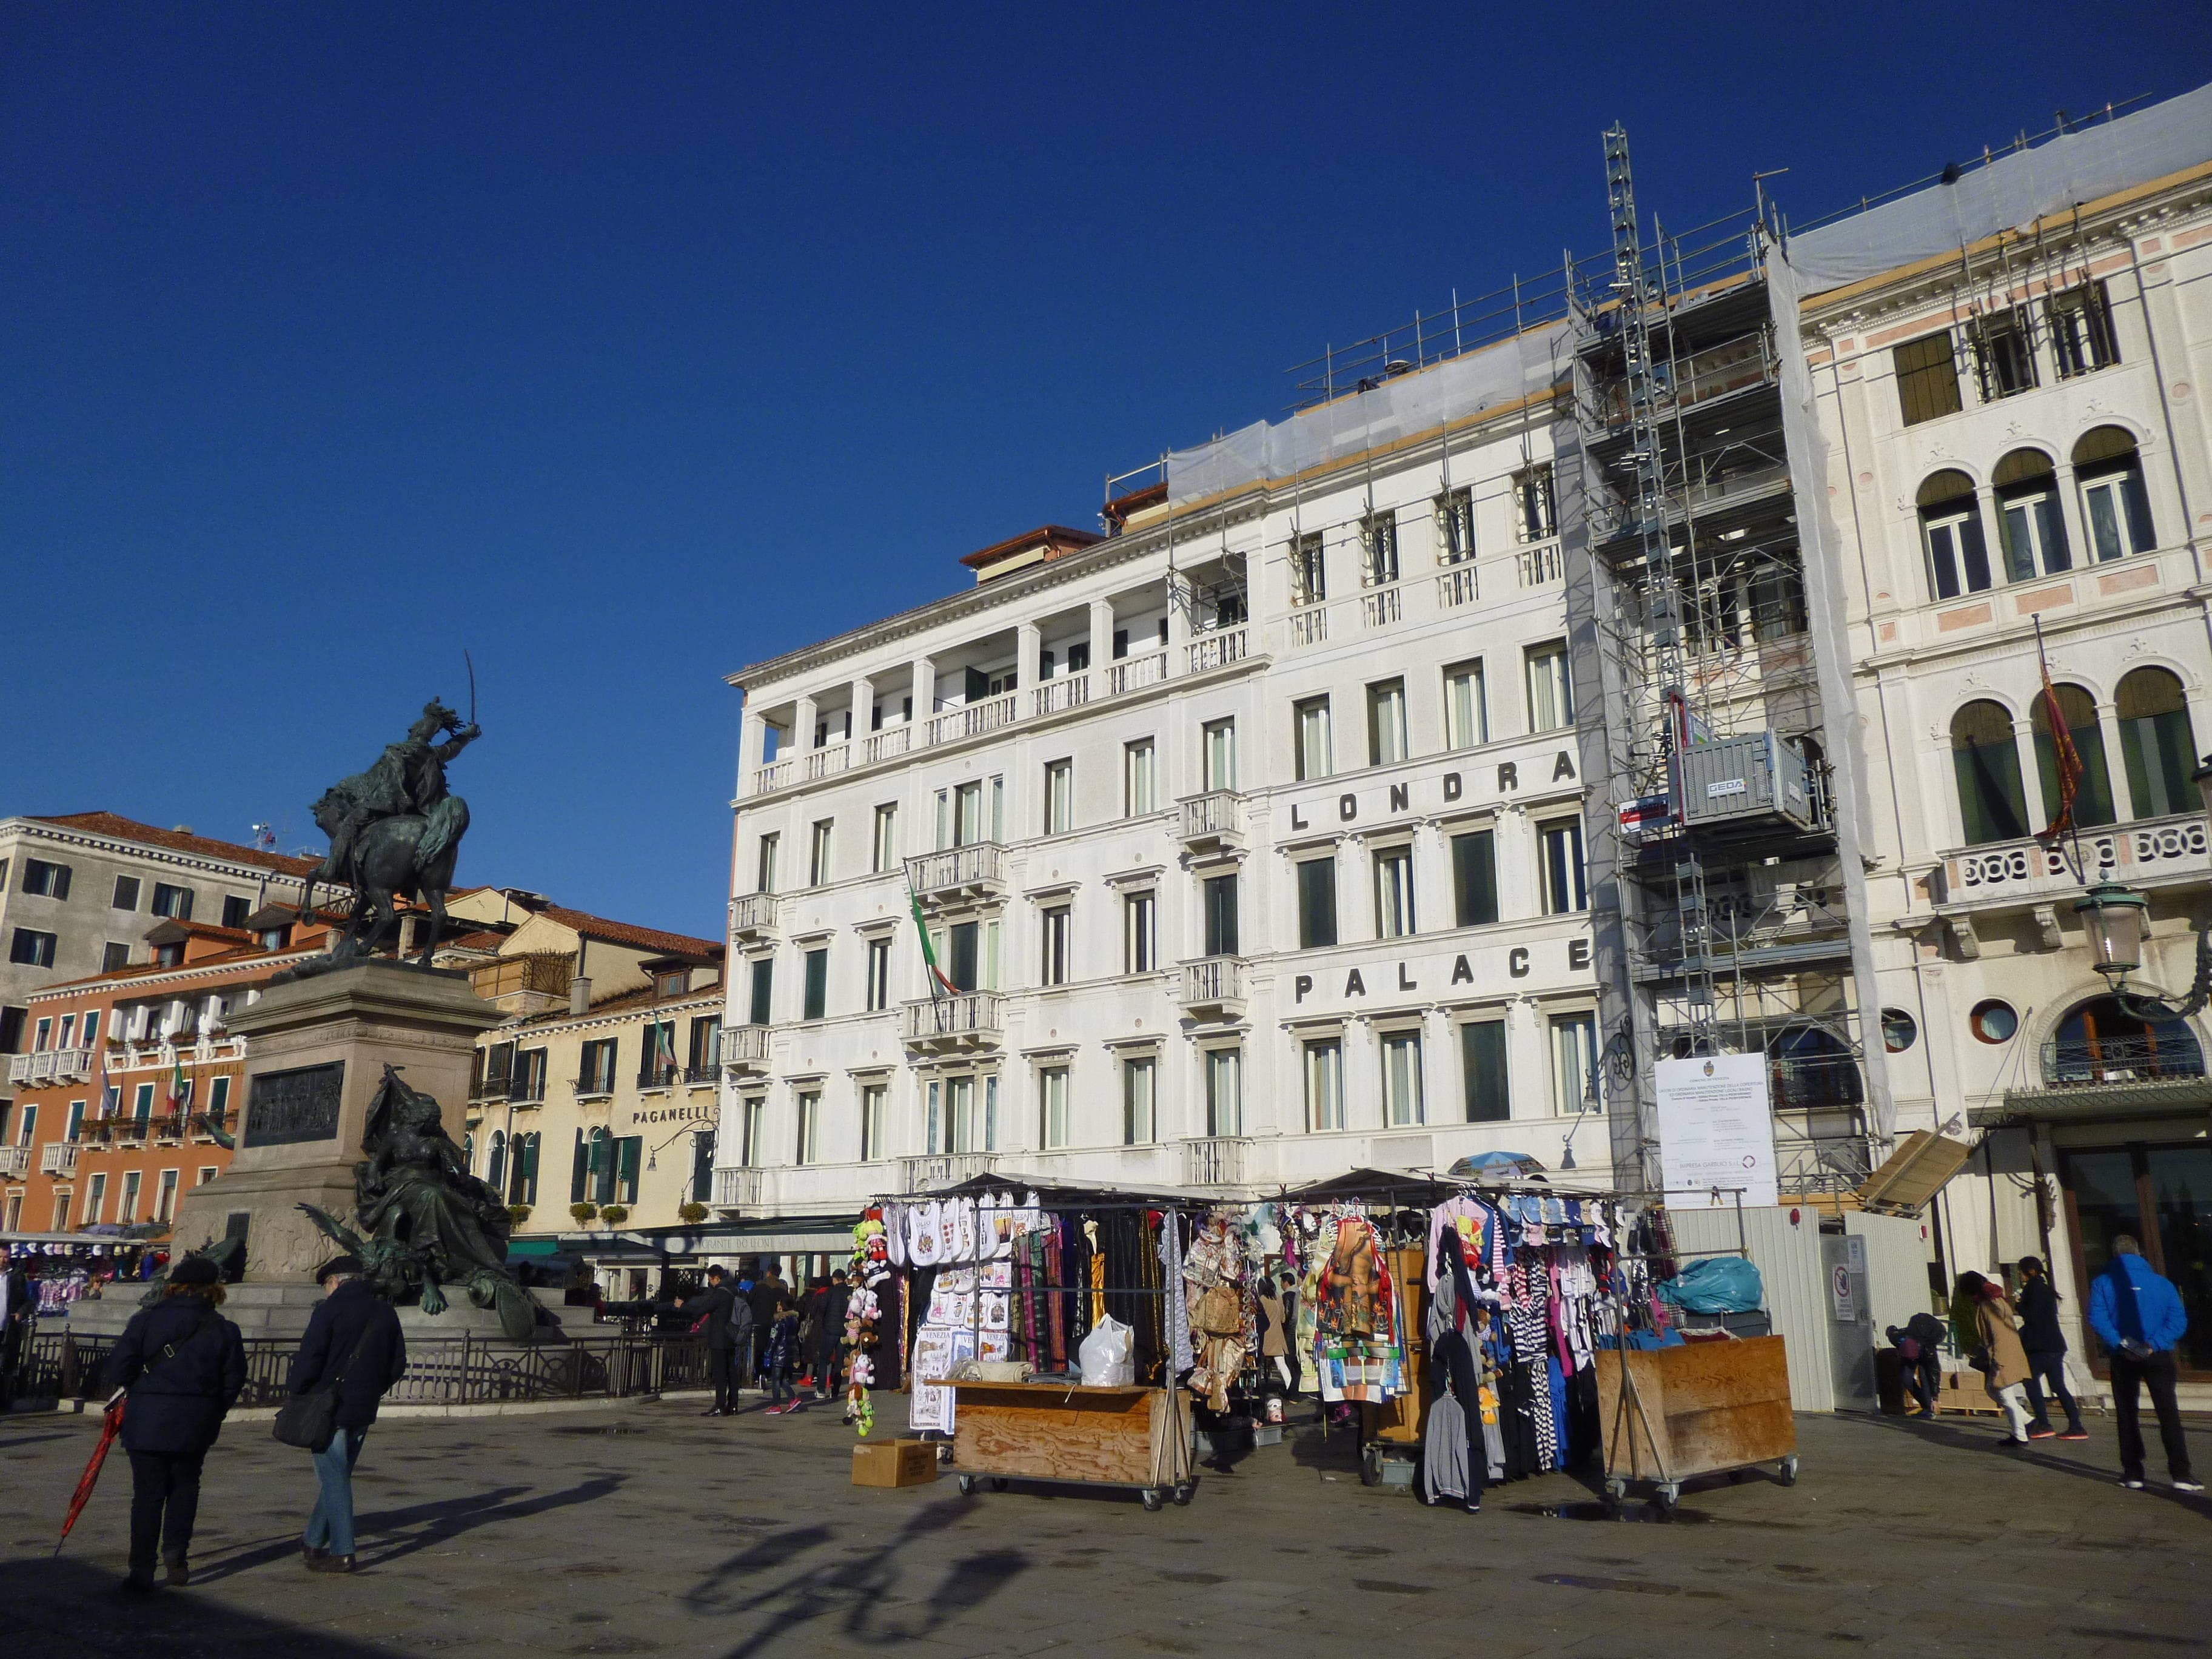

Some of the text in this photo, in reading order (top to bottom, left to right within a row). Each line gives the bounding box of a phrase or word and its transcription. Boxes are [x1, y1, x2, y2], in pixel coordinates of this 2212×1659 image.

[1291, 750, 1577, 831] LONDRA
[1709, 780, 1743, 793] GEDA
[1295, 938, 1590, 1004] PALACE
[632, 1105, 708, 1125] PAGANELLI
